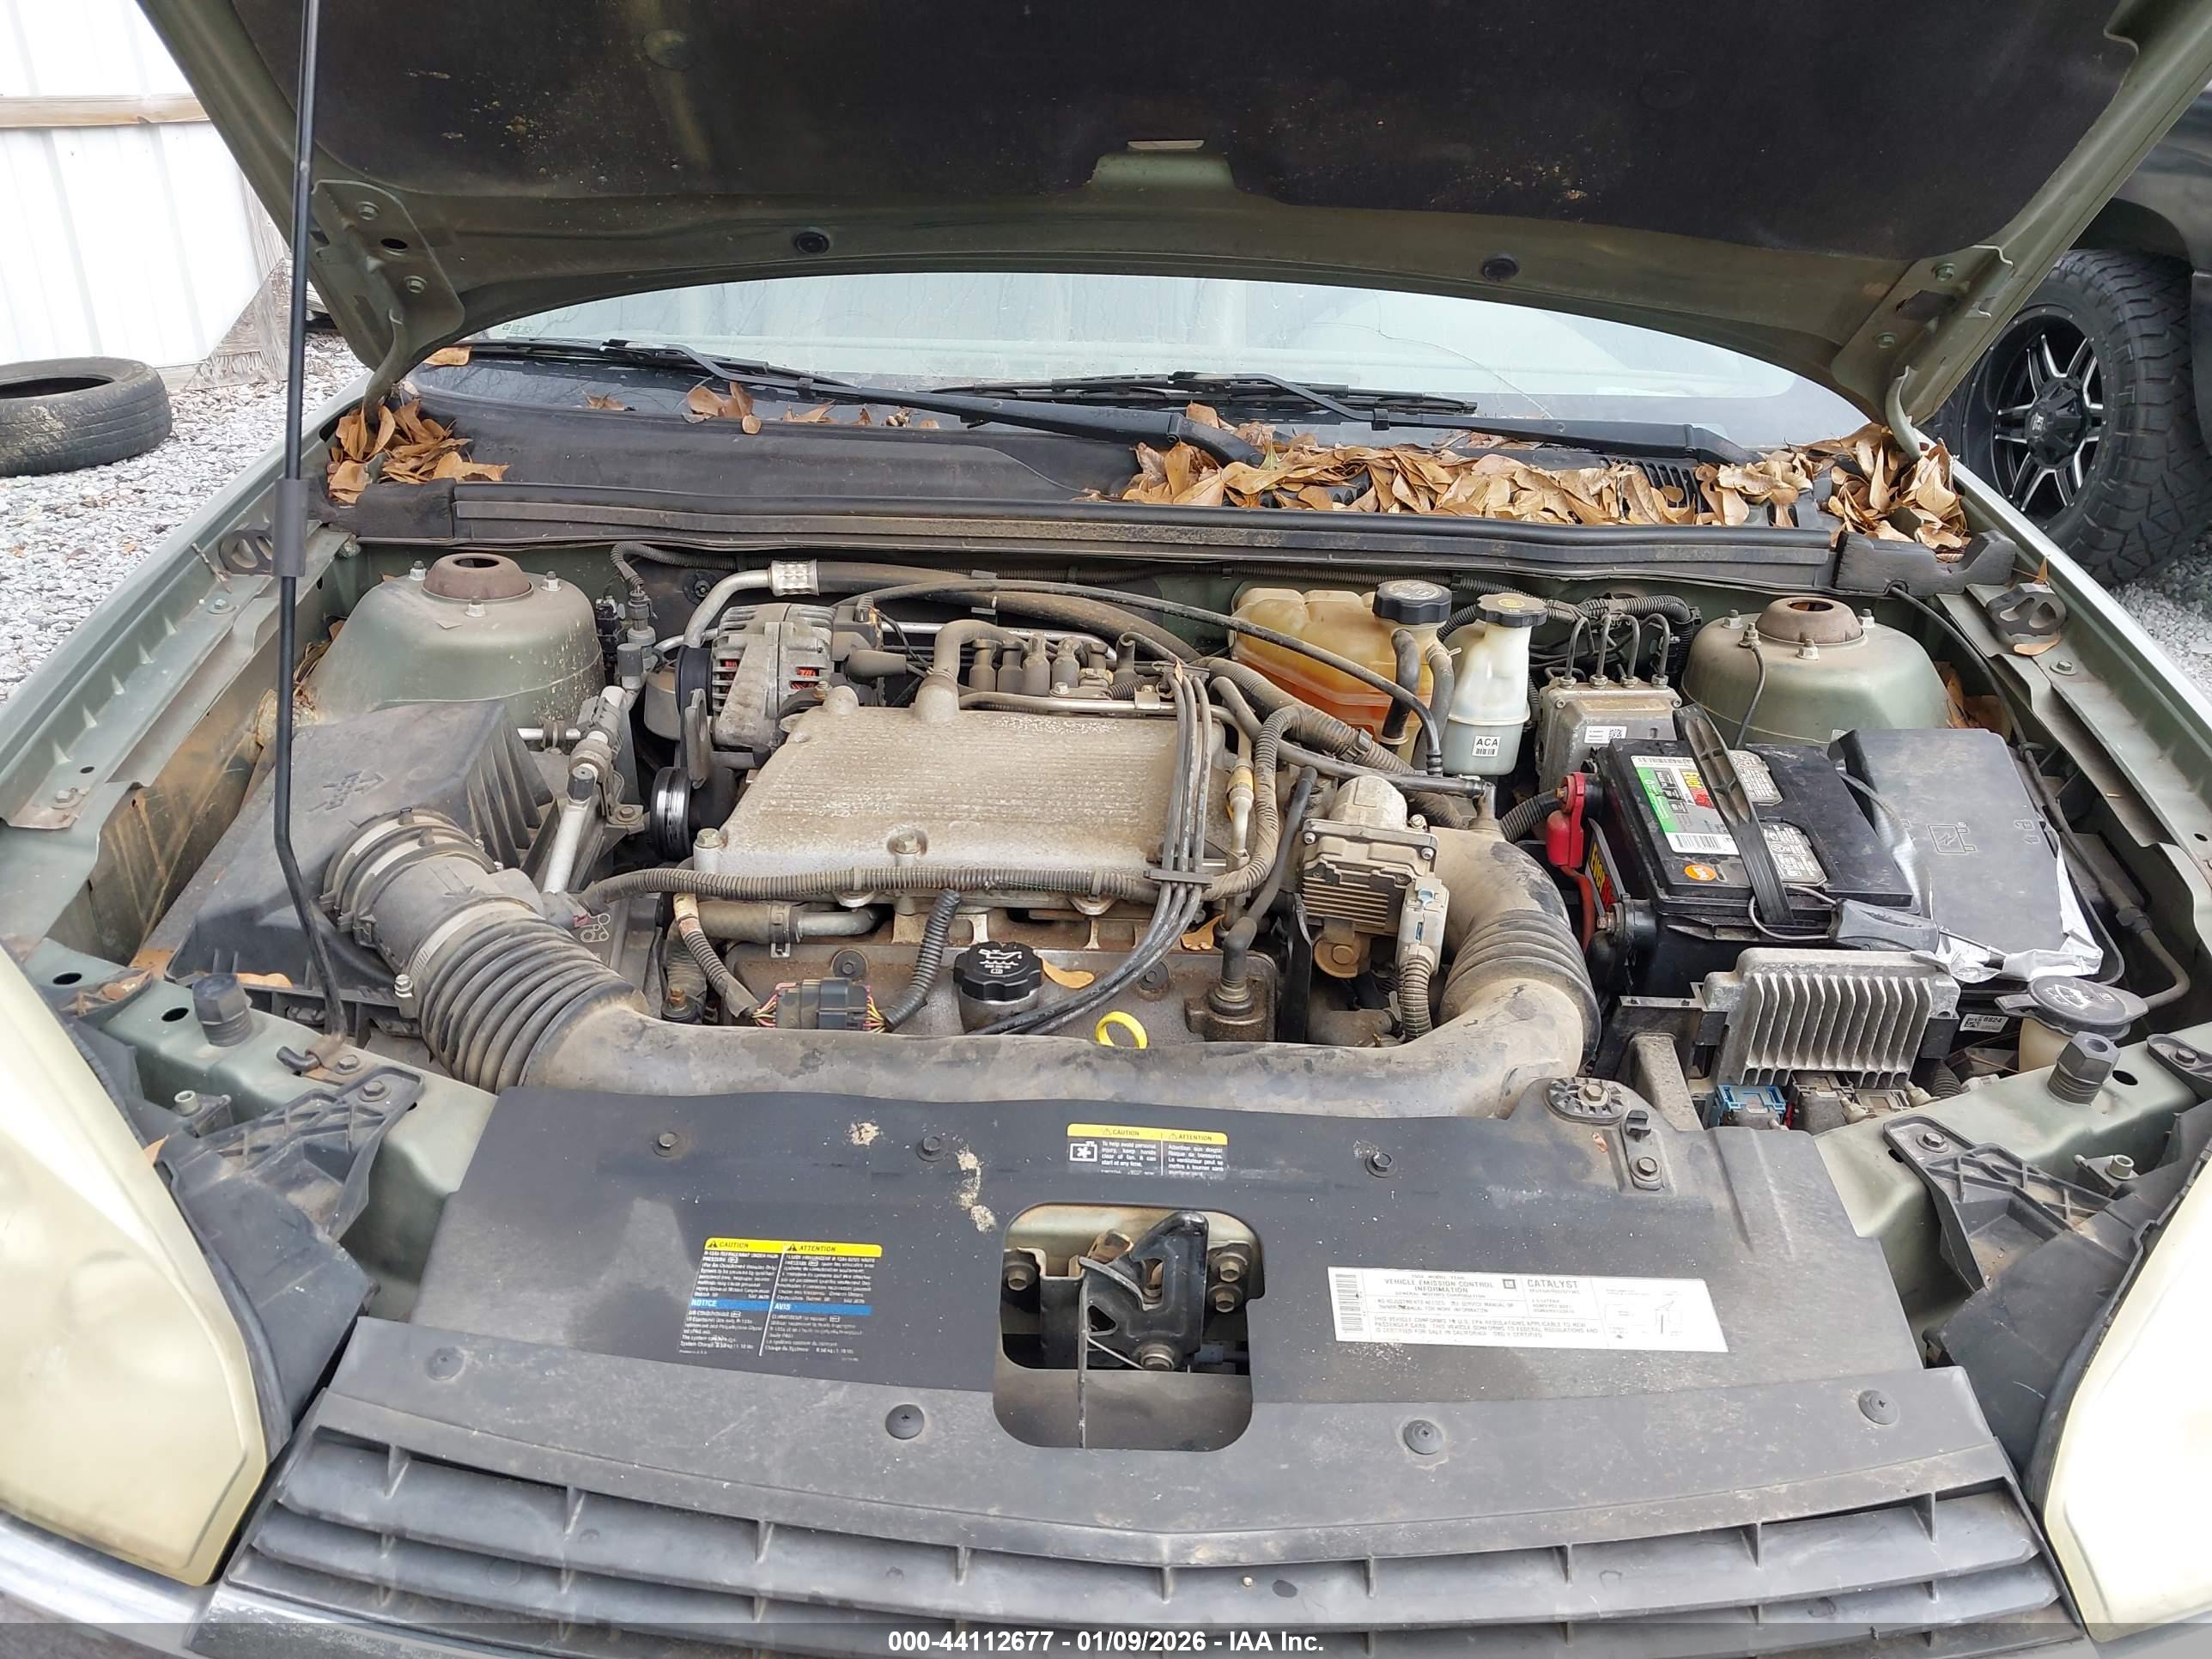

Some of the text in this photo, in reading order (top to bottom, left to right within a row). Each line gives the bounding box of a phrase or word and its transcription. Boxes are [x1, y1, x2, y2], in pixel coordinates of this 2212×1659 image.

[1476, 738, 1498, 746] ACA
[1526, 1279, 1579, 1289] CATALYST
[690, 1298, 718, 1307] NOTICE
